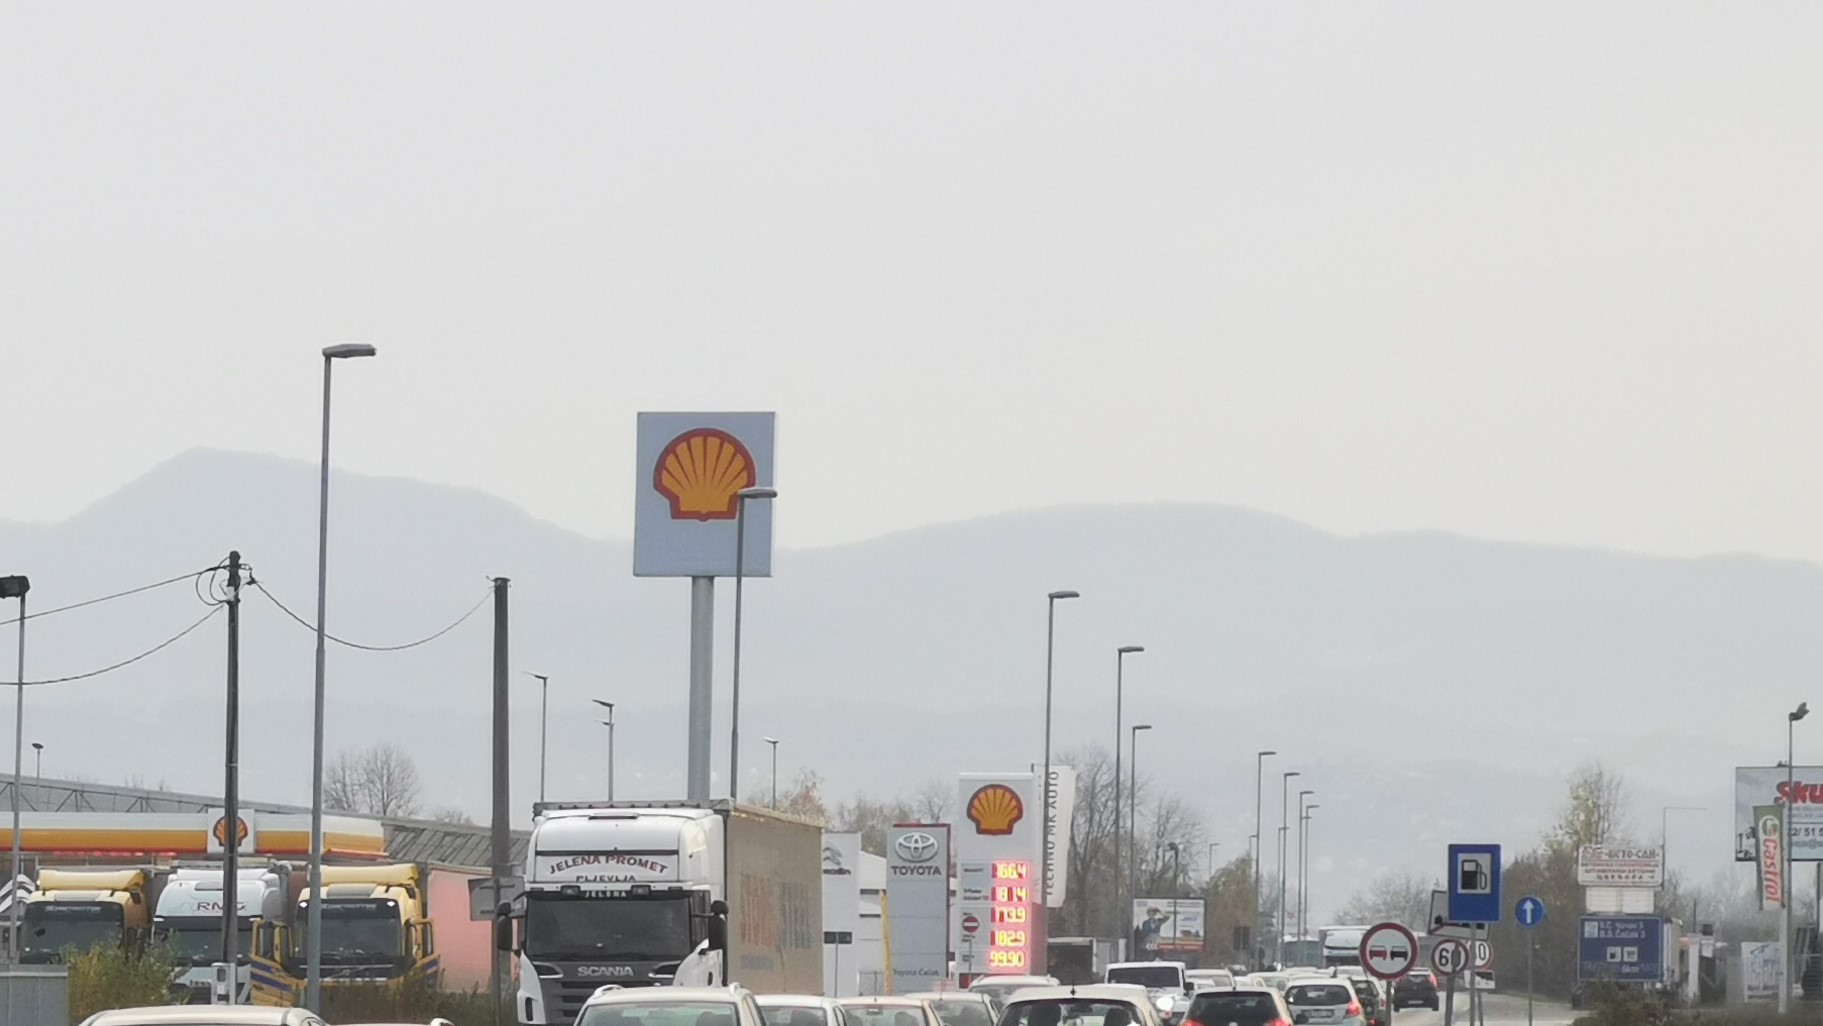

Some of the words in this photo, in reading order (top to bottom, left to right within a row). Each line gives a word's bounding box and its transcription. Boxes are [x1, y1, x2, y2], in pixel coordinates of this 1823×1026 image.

[549, 855, 601, 875] JELENA
[605, 854, 668, 874] PROMET
[891, 865, 943, 876] TOYOTA
[1762, 836, 1781, 902] Castrol
[577, 965, 634, 977] SCANIA
